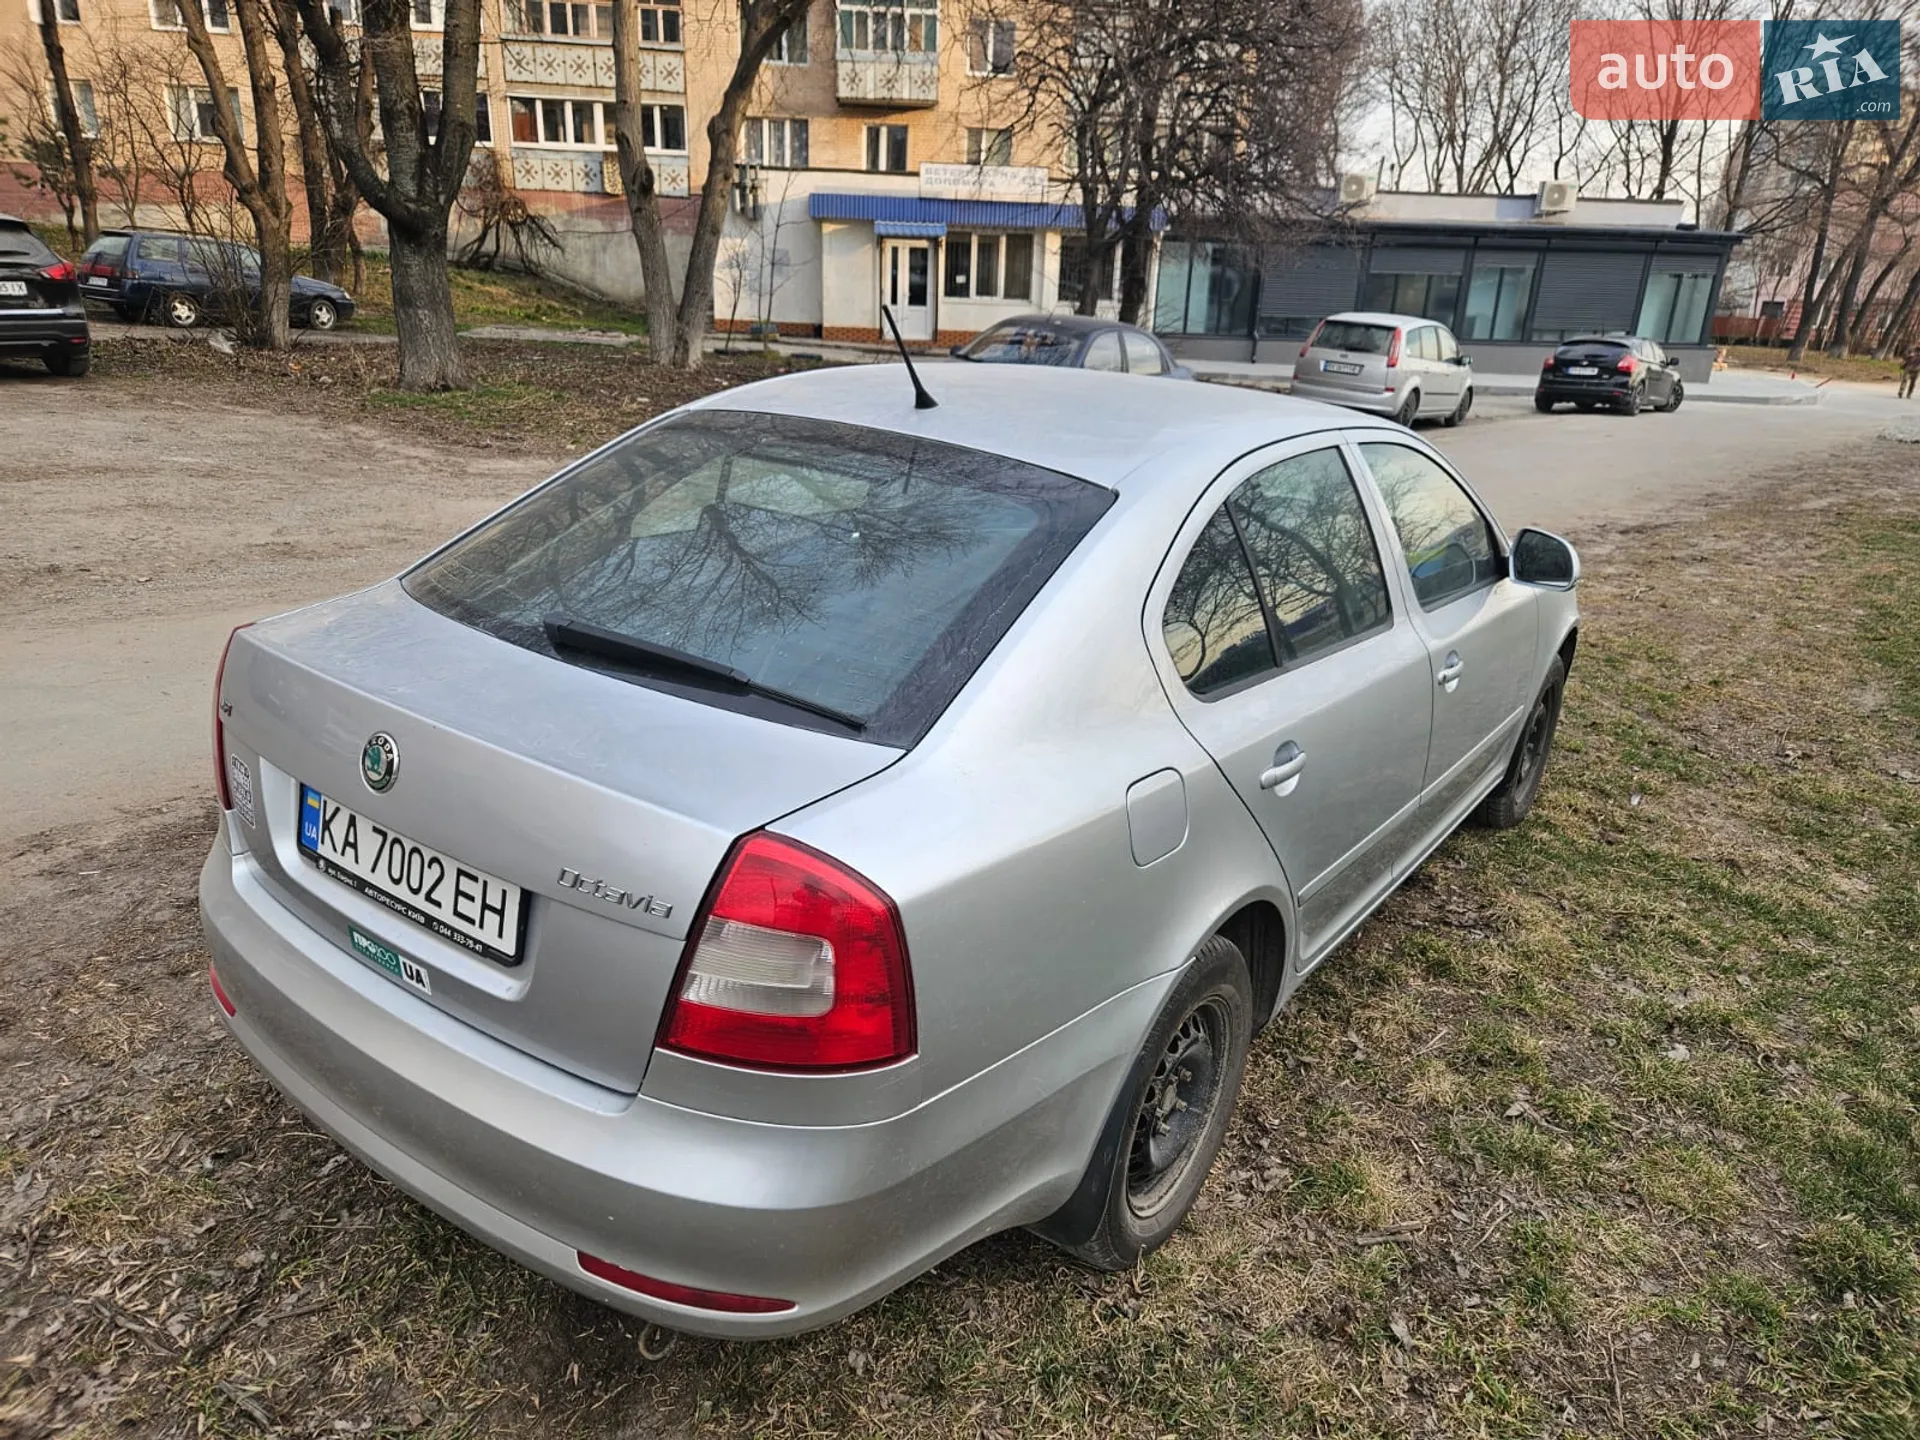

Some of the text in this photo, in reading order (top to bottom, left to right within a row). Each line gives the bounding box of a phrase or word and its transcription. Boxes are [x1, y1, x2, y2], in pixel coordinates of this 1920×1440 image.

[304, 822, 318, 840] UA
[320, 800, 507, 939] KA 7002 EH
[557, 866, 673, 919] Octavia
[402, 961, 426, 988] UA
